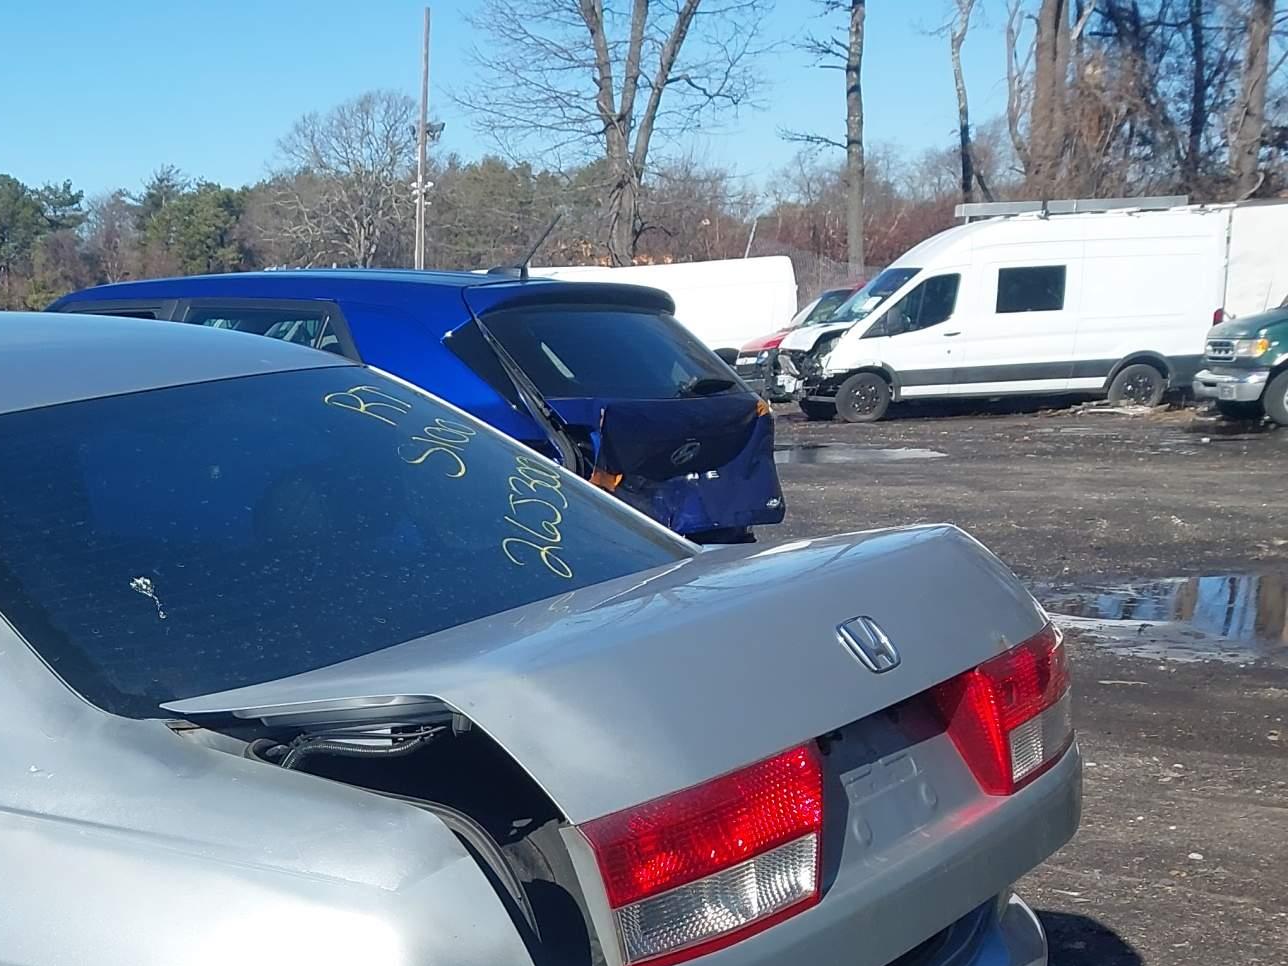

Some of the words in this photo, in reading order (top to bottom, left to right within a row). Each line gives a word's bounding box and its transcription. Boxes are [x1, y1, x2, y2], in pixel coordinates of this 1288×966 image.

[323, 385, 412, 427] RT
[396, 417, 478, 479] S100
[502, 454, 574, 579] 26J300
